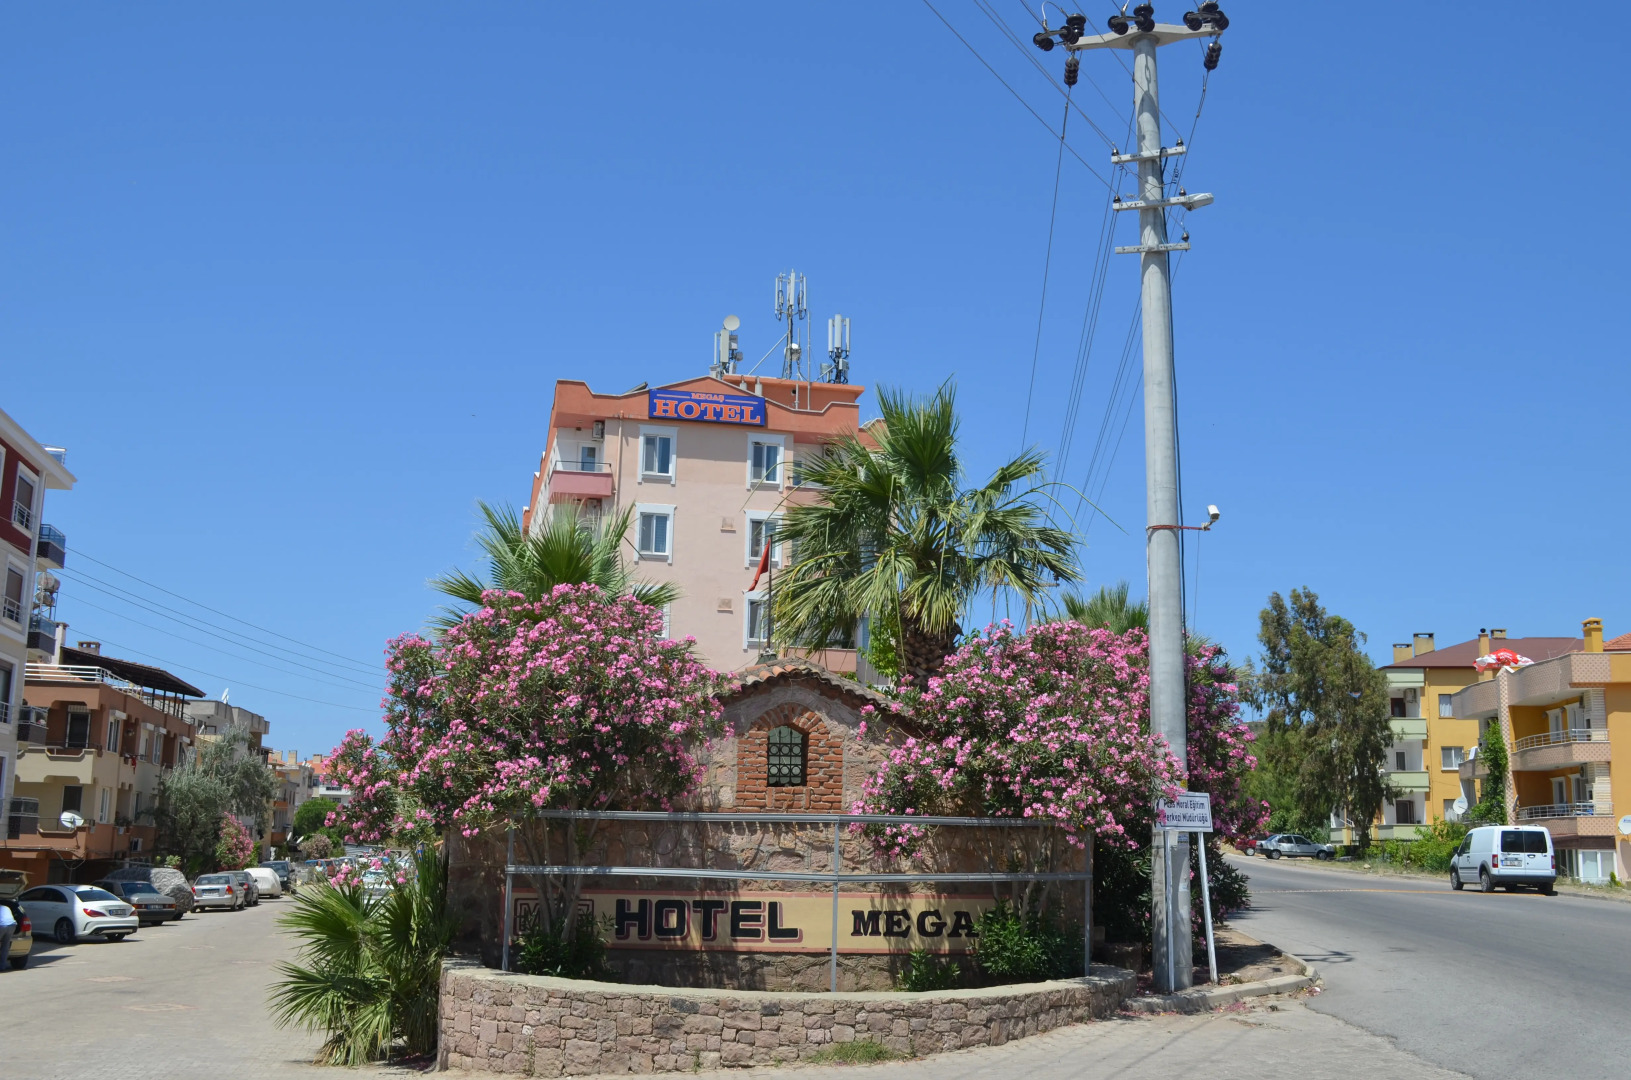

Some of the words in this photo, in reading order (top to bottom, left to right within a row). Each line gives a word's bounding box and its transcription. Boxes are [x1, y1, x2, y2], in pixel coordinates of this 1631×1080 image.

[653, 399, 760, 424] HOTEL
[1163, 812, 1182, 822] erkezi
[614, 897, 803, 943] HOTEL
